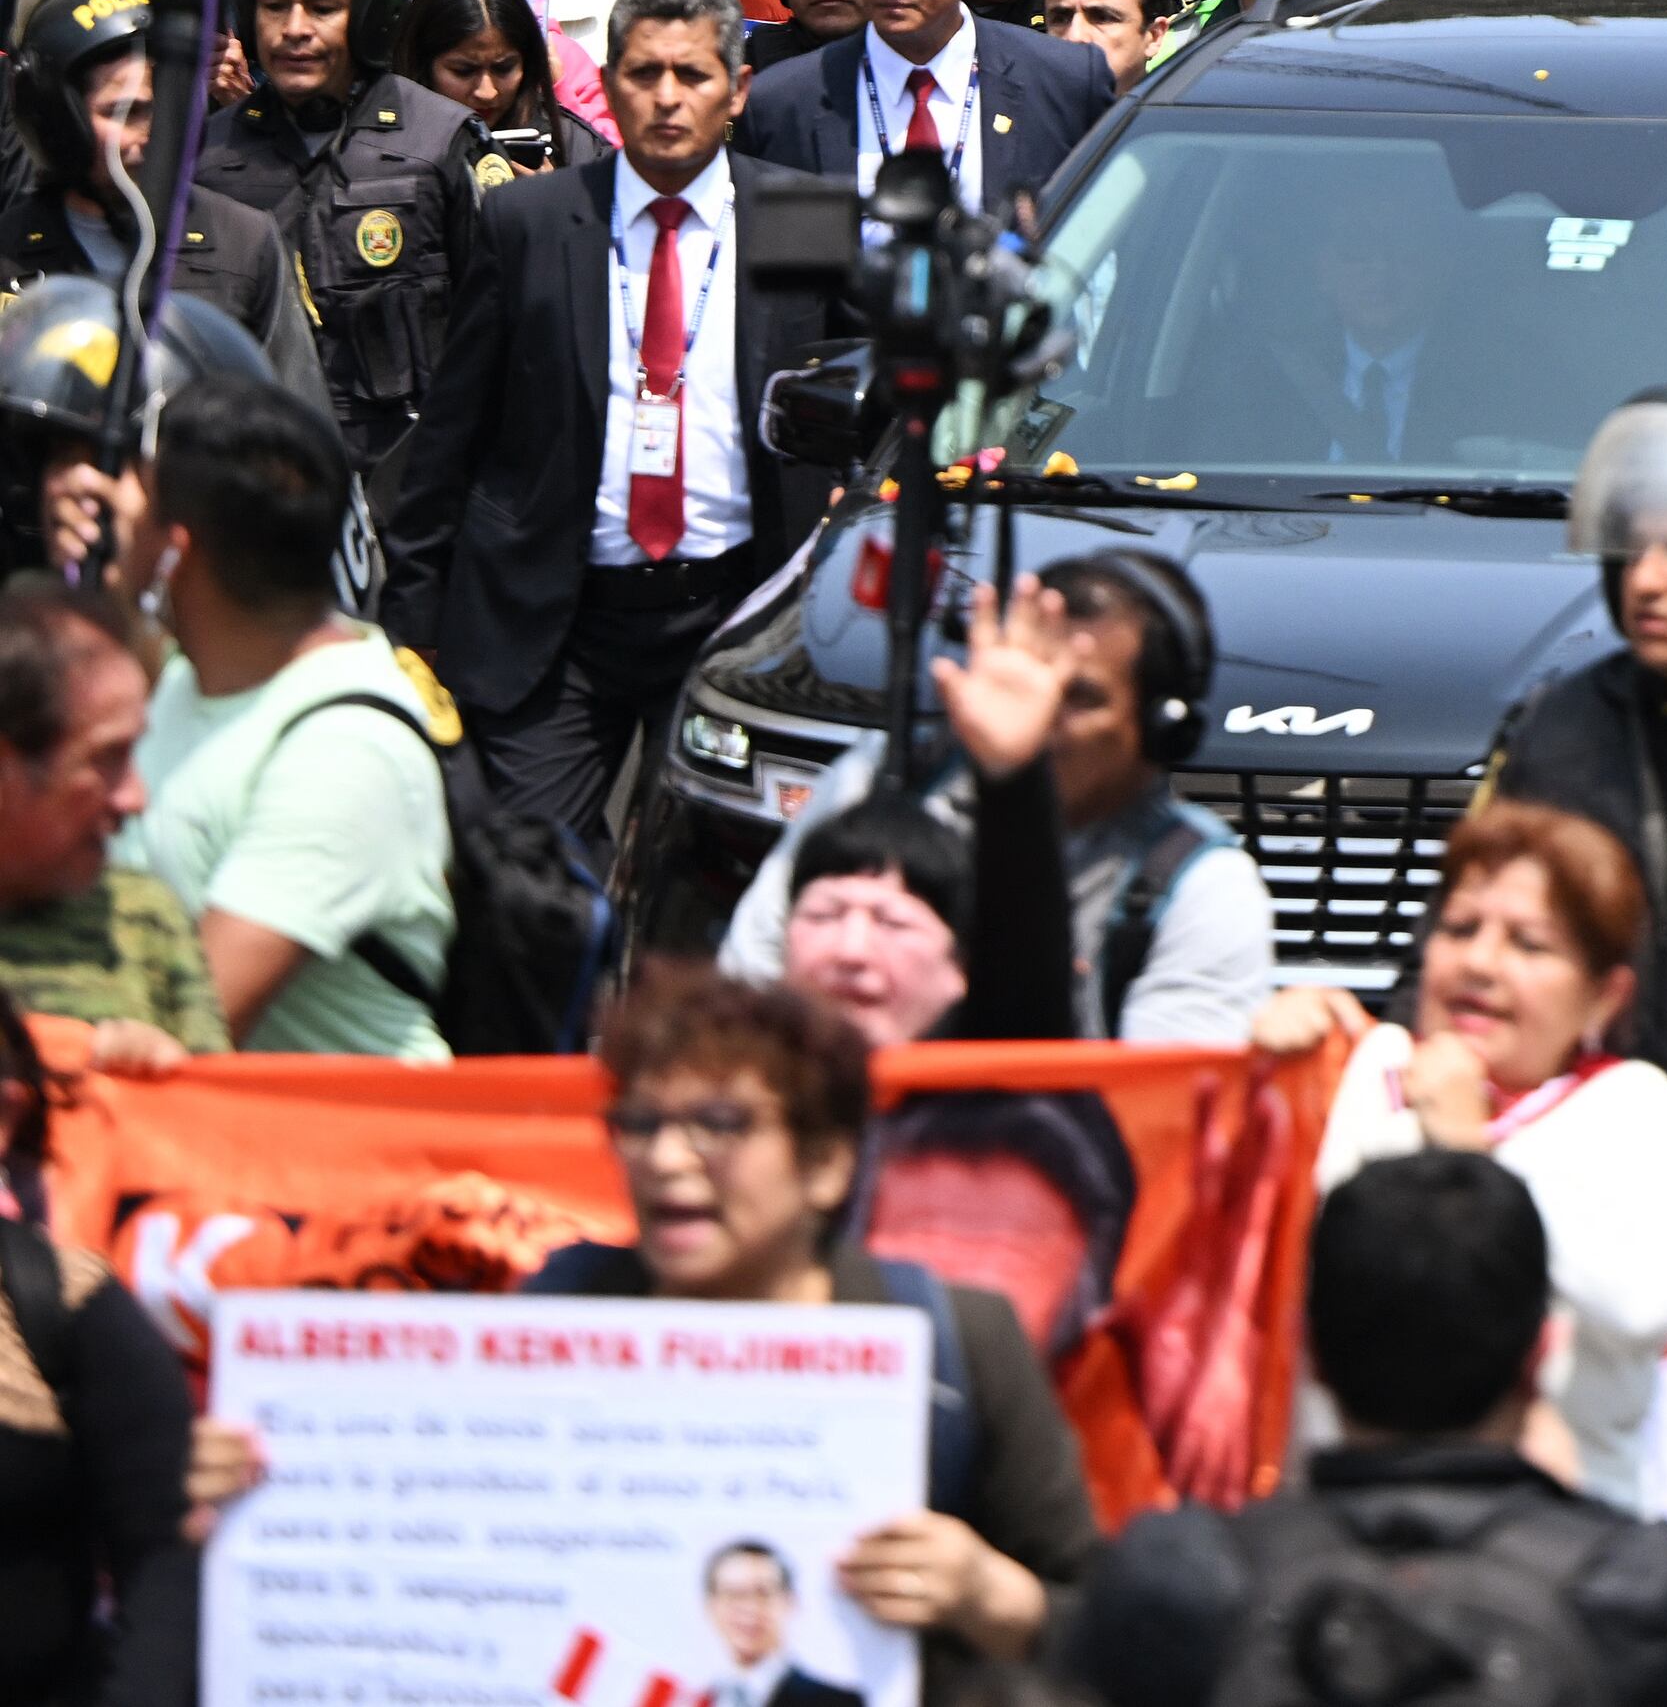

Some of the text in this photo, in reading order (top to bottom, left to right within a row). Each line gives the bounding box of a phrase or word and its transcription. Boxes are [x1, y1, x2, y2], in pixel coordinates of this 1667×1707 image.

[236, 1318, 907, 1377] ALBERTO KENYA FUJIMORI
